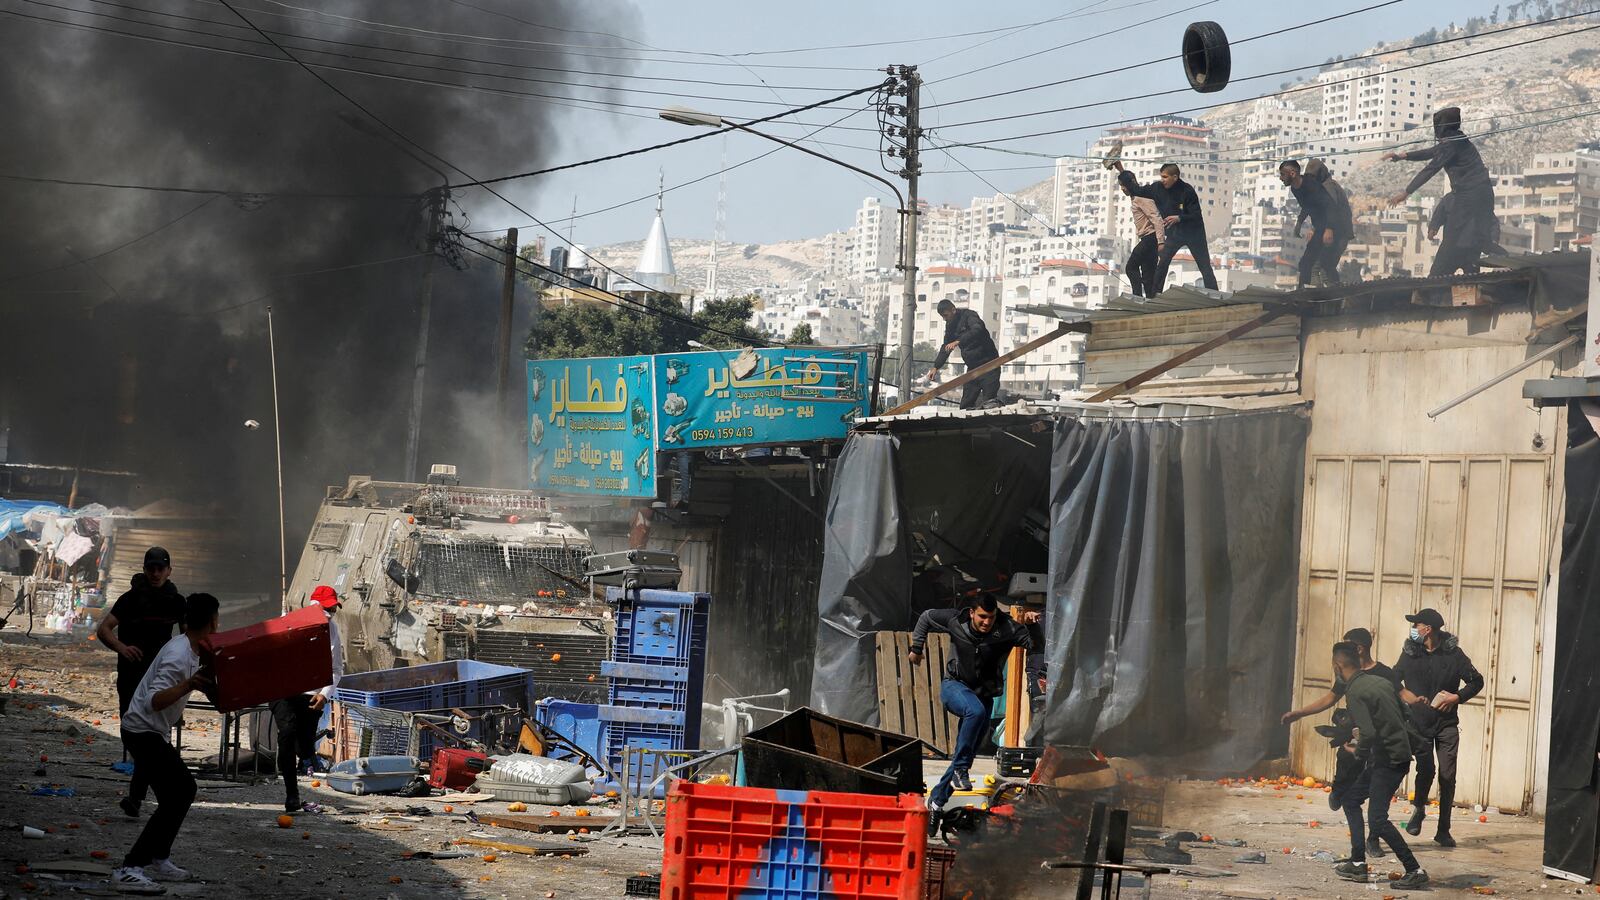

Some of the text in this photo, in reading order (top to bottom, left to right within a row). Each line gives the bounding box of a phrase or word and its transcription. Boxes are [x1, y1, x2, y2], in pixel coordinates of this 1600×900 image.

[549, 363, 628, 428] فطاير
[714, 402, 741, 423] تأجير
[752, 403, 785, 420] صيانة
[796, 404, 815, 418] بيع
[691, 427, 753, 441] 0594 159 413
[553, 433, 573, 469] تأجير
[580, 442, 601, 471] صيانة
[609, 450, 624, 472] بيع
